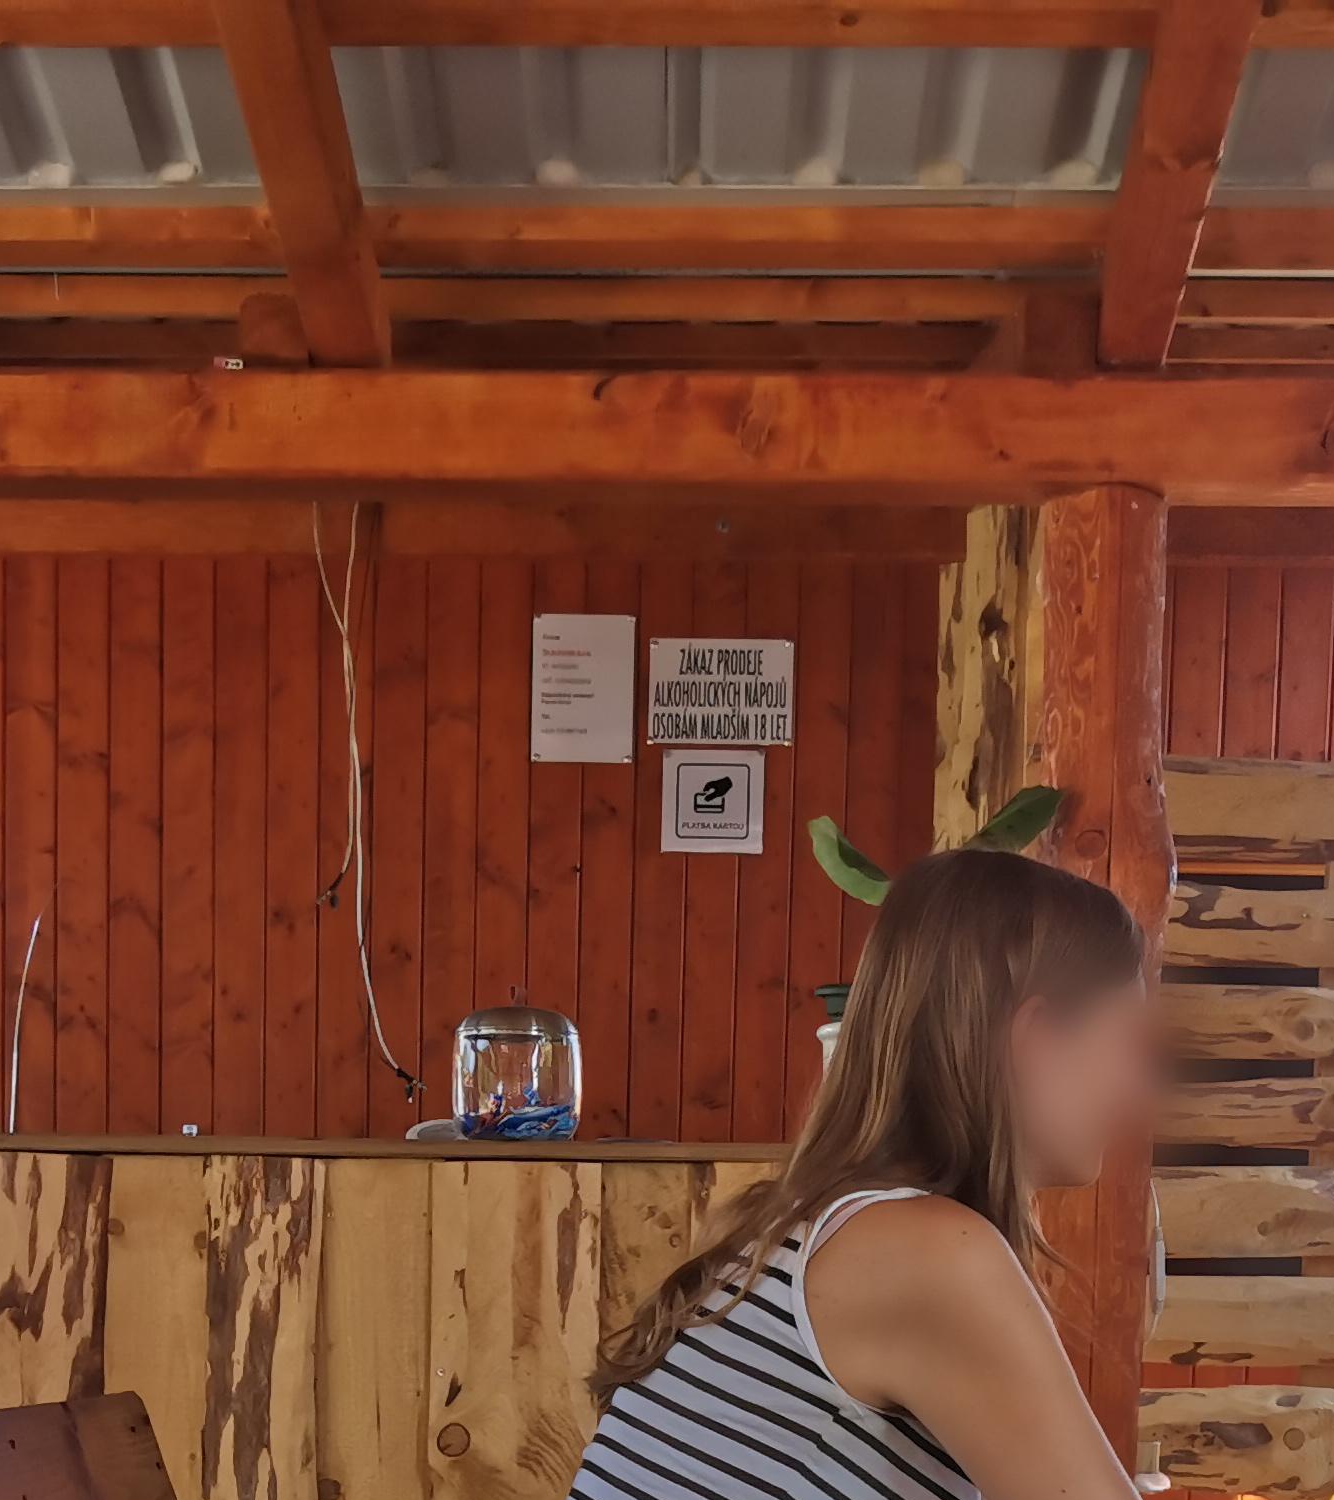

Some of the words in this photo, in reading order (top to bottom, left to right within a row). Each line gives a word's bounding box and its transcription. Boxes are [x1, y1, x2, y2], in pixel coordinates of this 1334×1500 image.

[679, 643, 713, 675] ZÁKAZ
[717, 649, 763, 676] PRODEJE
[653, 676, 741, 707] ALKOHOLICKÝCH
[744, 676, 787, 708] NÁPOJŮ
[652, 709, 698, 740] OSOBÁM
[700, 709, 749, 740] MLADŠÍM
[754, 714, 767, 740] 18
[770, 714, 788, 740] LET
